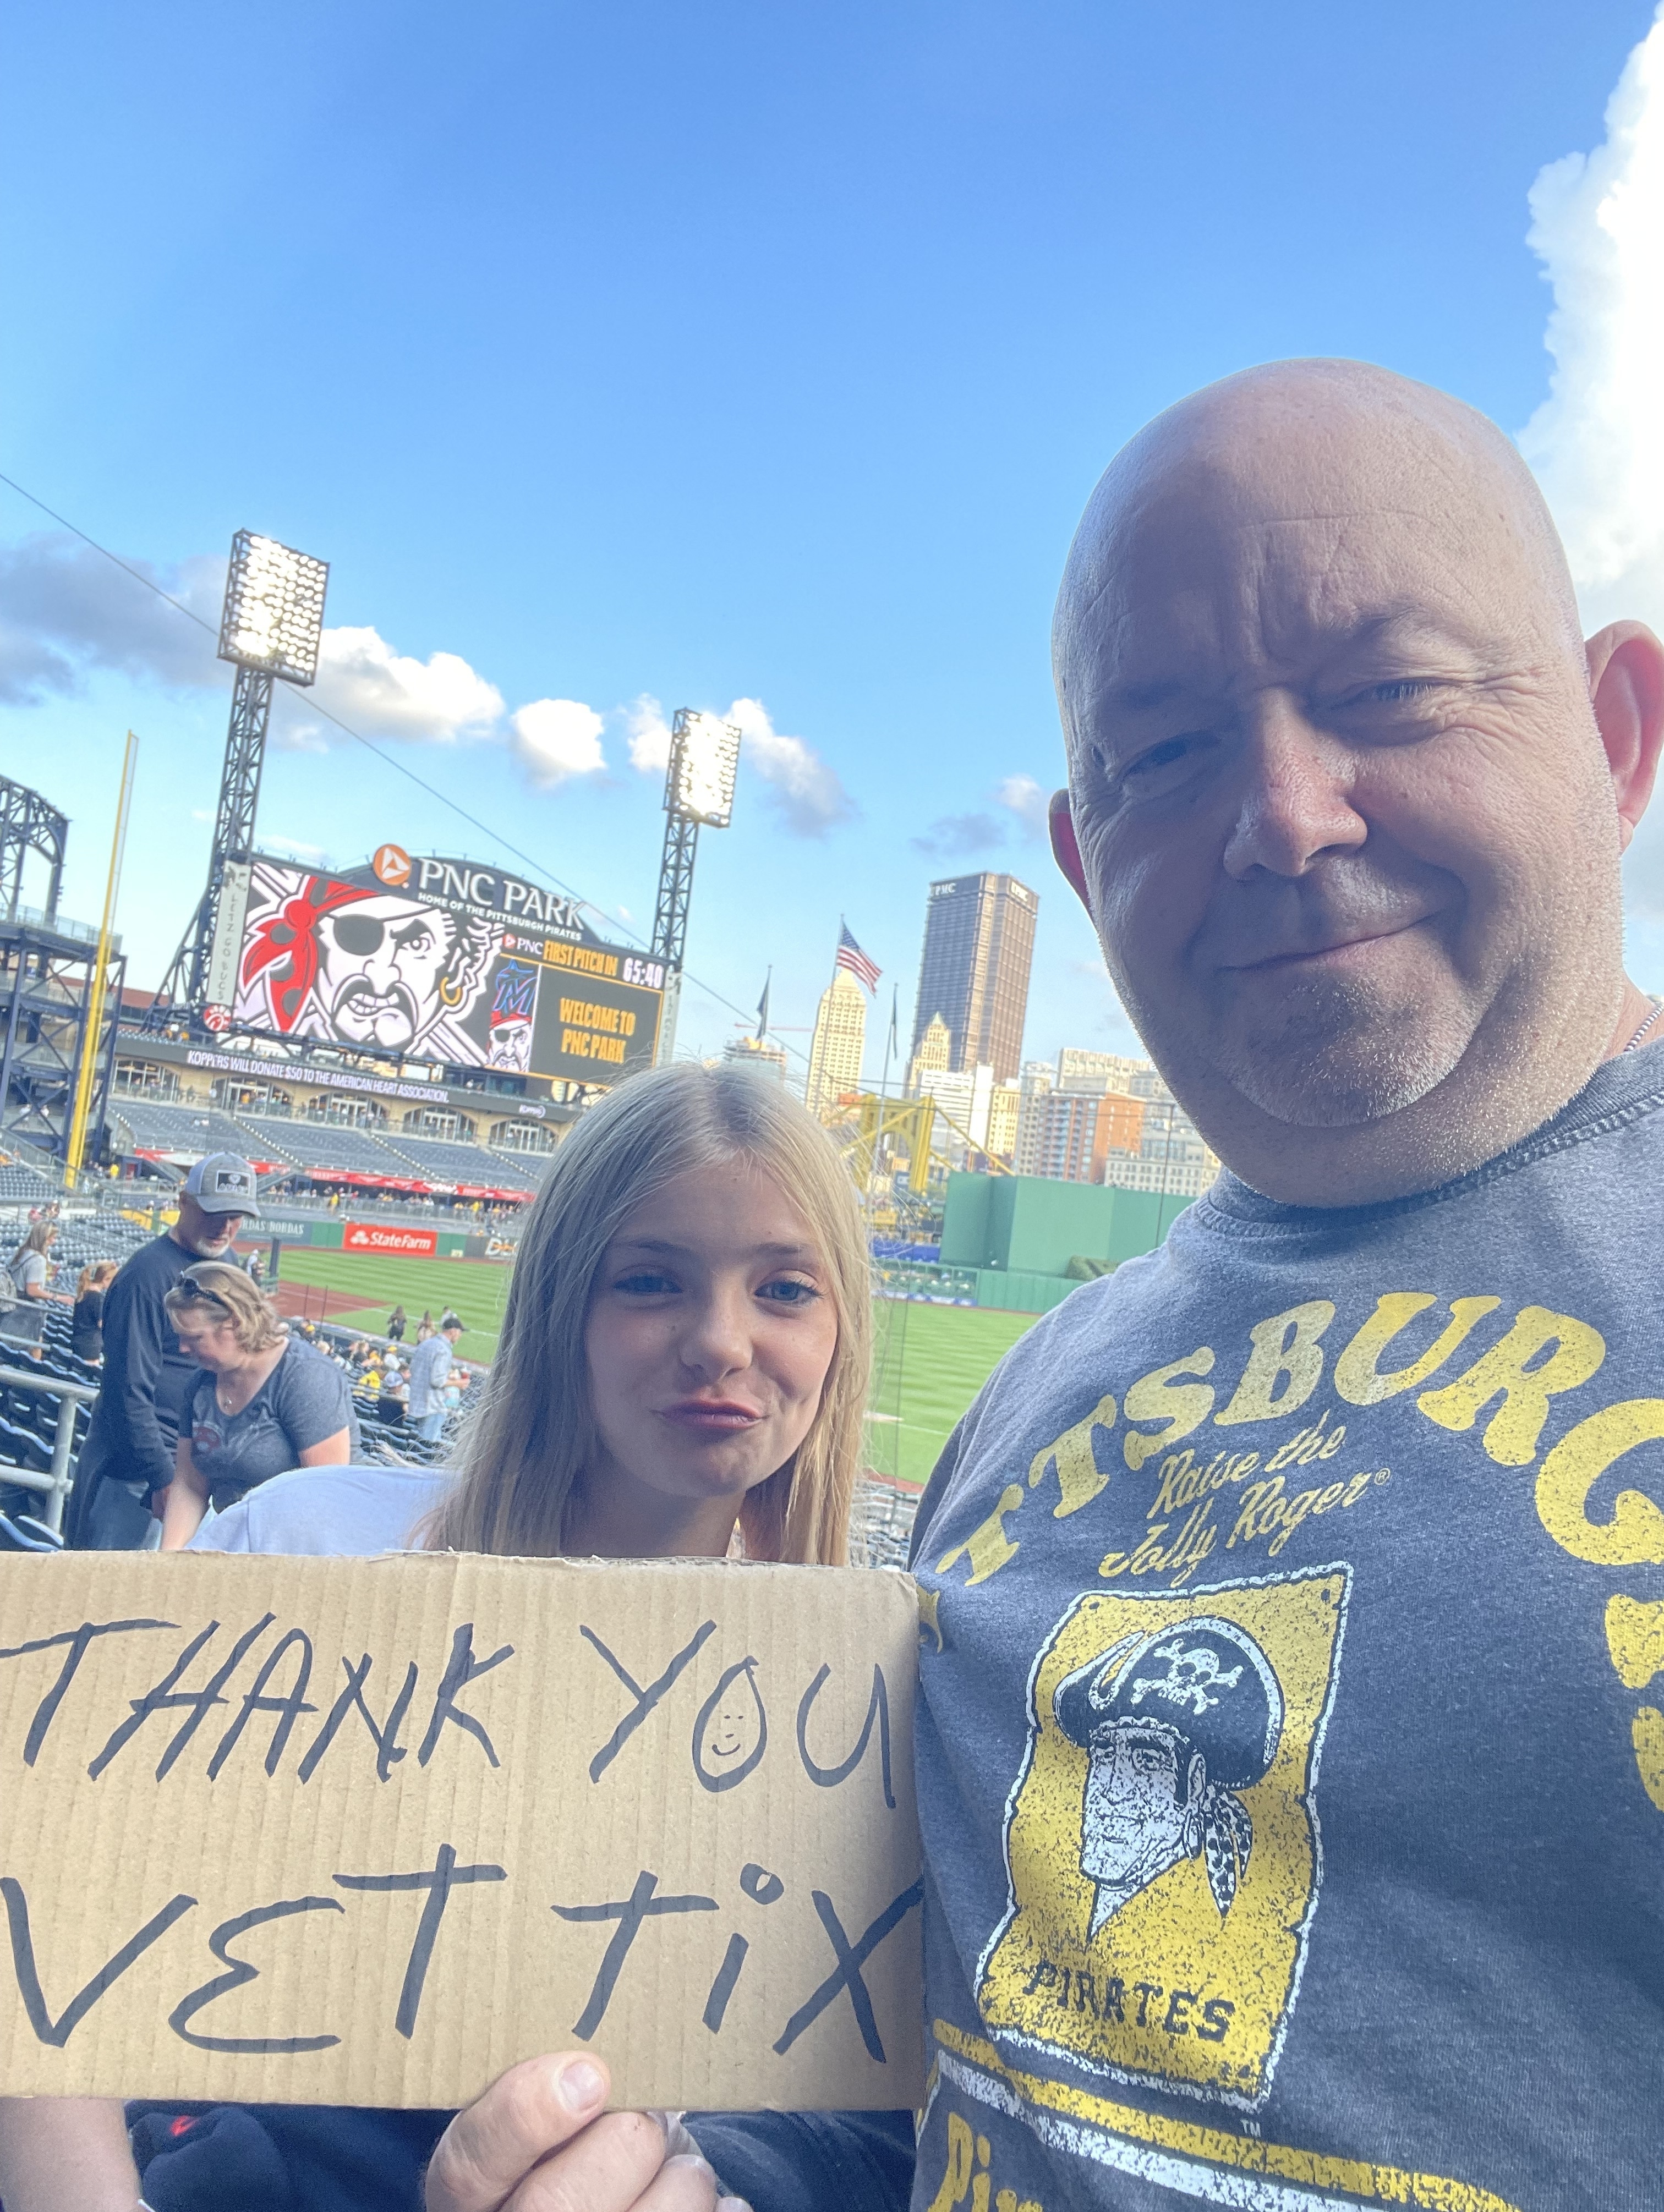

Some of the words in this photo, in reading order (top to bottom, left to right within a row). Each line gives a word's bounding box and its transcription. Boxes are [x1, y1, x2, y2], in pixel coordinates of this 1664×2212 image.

[418, 858, 495, 906] PNC
[503, 880, 586, 930] PARK
[930, 882, 956, 897] PMC
[418, 892, 448, 907] HOME
[450, 899, 464, 911] OF
[466, 903, 485, 918] THE
[486, 909, 543, 932] PITTSBURGH
[545, 924, 582, 941] PIRATES
[517, 937, 543, 954] PNC
[543, 939, 574, 967] FIRST
[573, 947, 605, 973] PITCH
[605, 953, 618, 976] IN
[560, 997, 620, 1033] WELCOME
[619, 1010, 636, 1036] TO
[561, 1028, 590, 1057] PNC
[589, 1034, 627, 1064] PARK
[229, 1057, 249, 1073] WILL
[250, 1061, 285, 1078] DONATE
[285, 1066, 303, 1080] $50
[304, 1069, 315, 1082] TO
[315, 1071, 330, 1085] THE
[330, 1073, 373, 1091] AMERICAN
[373, 1079, 398, 1095] HEART
[242, 1219, 266, 1231] RDAS
[1147, 1448, 1260, 1519] Raise
[1265, 1409, 1346, 1474] the
[1098, 1503, 1218, 1588] Jolly
[0, 1612, 514, 1784] THANK
[579, 1620, 896, 1809] YOU
[0, 1843, 508, 2053] VET
[1023, 1960, 1234, 2043] PIRATES
